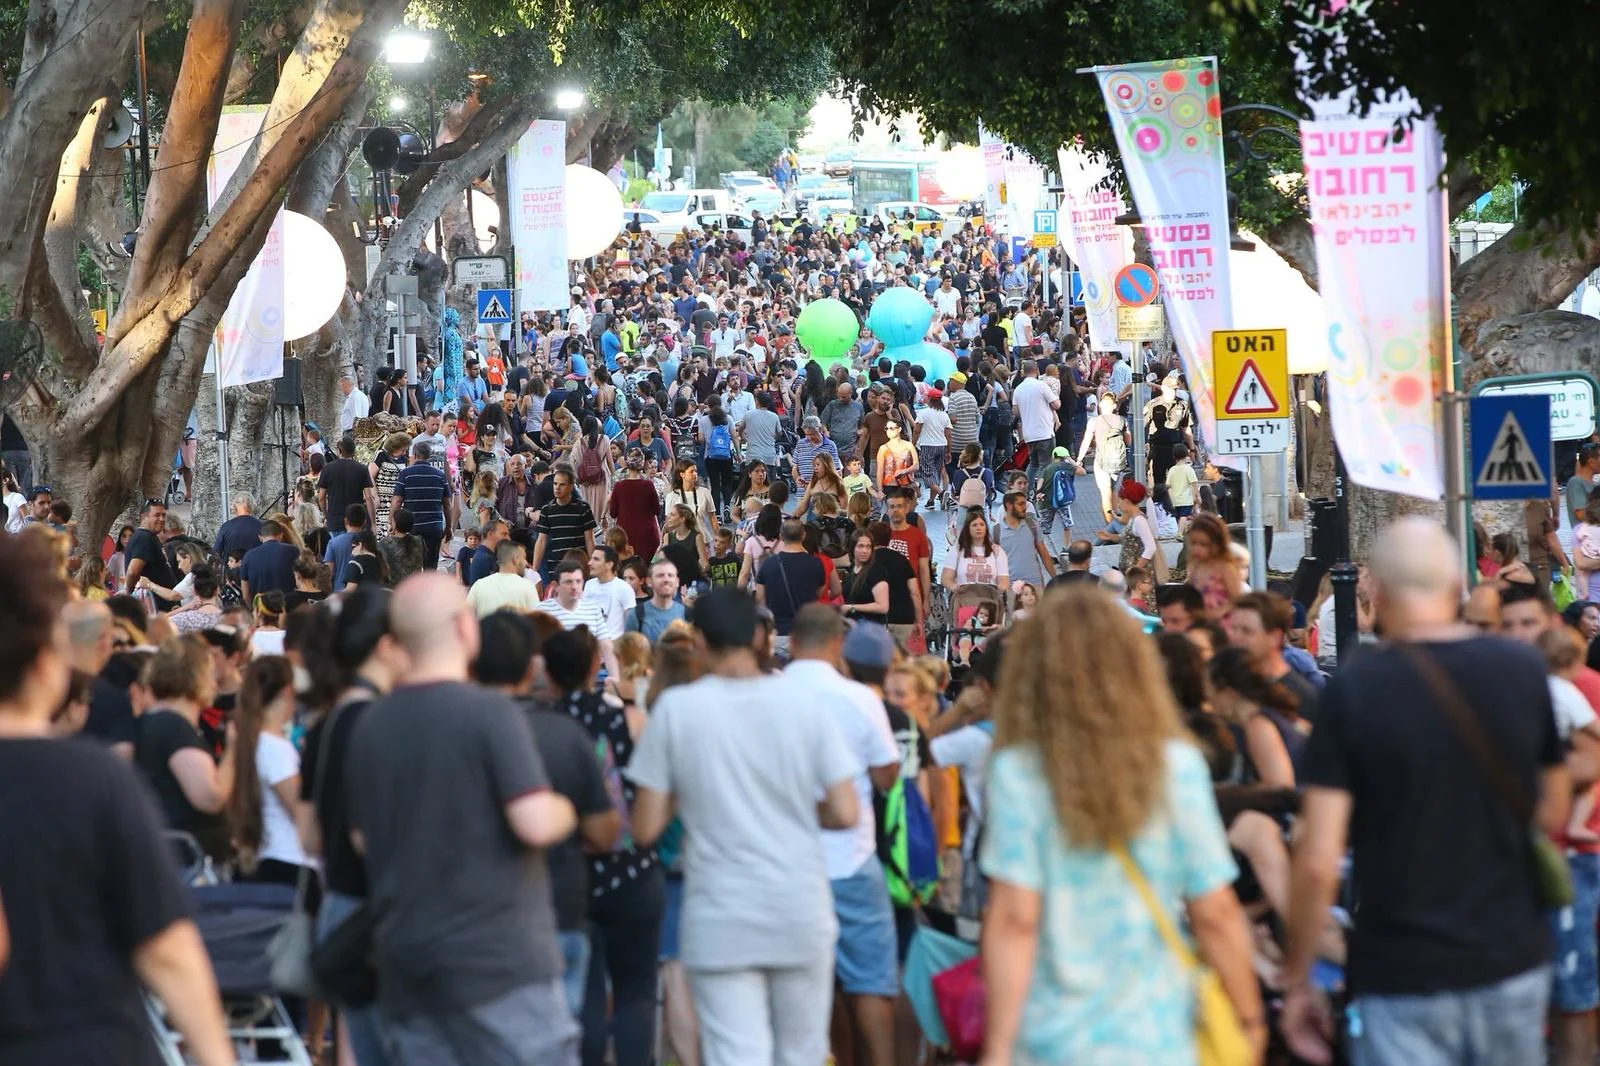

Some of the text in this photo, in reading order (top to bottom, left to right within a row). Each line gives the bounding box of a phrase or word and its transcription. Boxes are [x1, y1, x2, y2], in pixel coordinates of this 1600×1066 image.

[1308, 129, 1414, 156] פסטיב
[1315, 165, 1415, 196] רחובו
[1226, 335, 1275, 353] האט
[1240, 421, 1280, 435] ילדים
[1225, 438, 1261, 452] בדרך
